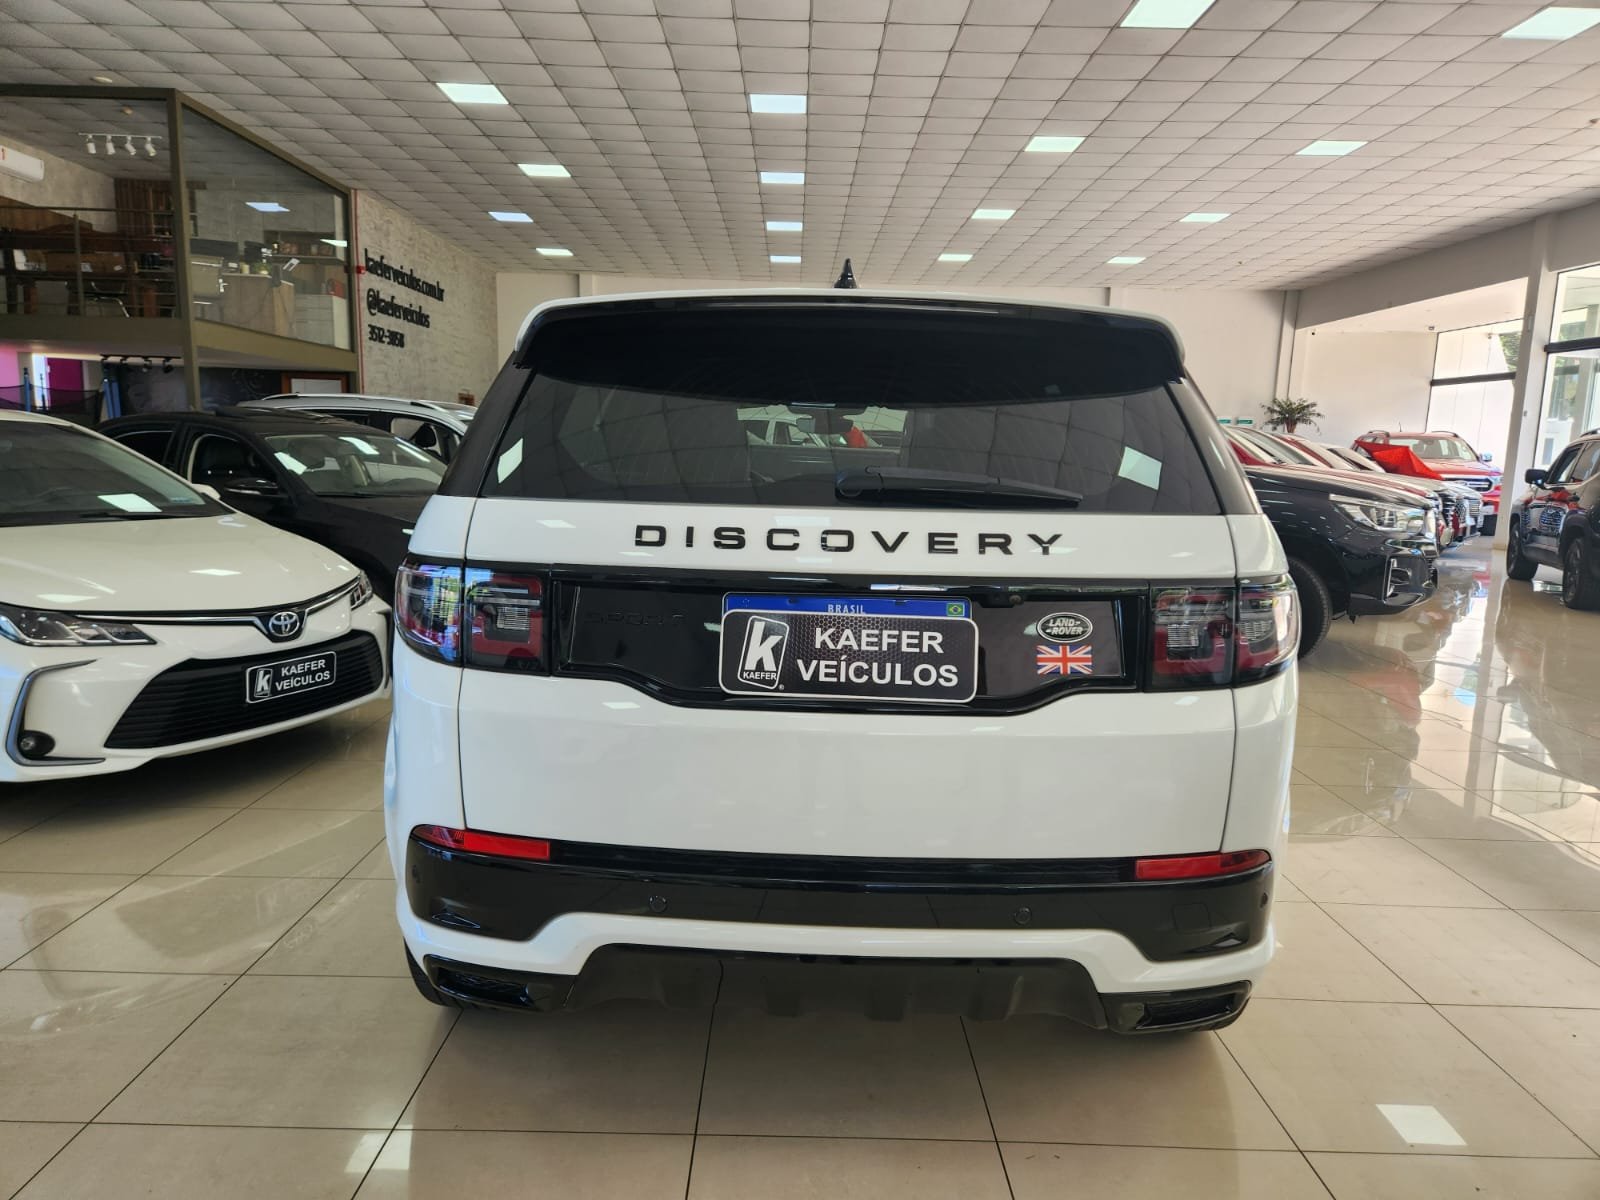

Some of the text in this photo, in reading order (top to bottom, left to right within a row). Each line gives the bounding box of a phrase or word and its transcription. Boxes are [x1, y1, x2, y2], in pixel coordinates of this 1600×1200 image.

[634, 524, 1063, 556] DISCOVERY
[827, 604, 866, 614] BRASIL
[584, 611, 687, 625] SPORT
[1048, 618, 1076, 627] LAND
[1051, 626, 1084, 635] ROVER
[813, 626, 945, 655] KAEFER
[281, 659, 326, 677] KAEFER
[743, 671, 777, 681] KAEFER
[796, 656, 960, 688] VEÍCULOS
[276, 671, 330, 690] VEÍCULOS
